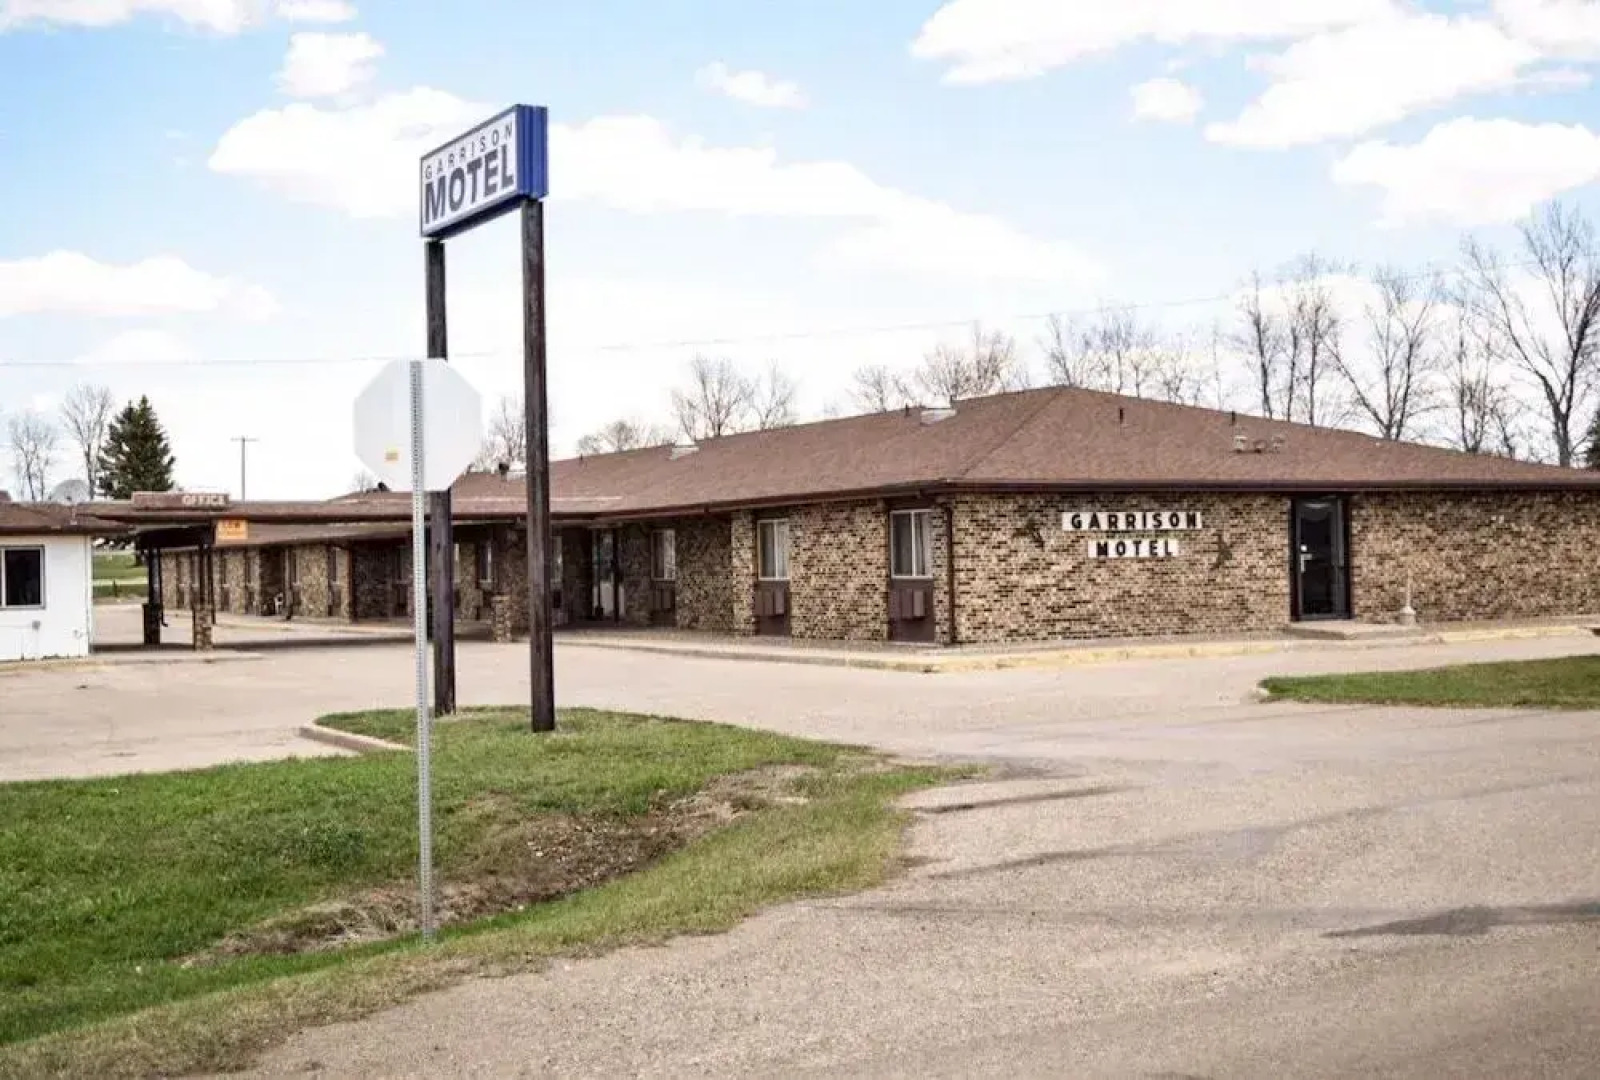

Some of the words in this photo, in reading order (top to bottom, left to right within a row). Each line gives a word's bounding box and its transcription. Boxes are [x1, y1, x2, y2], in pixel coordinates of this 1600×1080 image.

[425, 122, 513, 179] GARRISON
[425, 144, 514, 224] MOTEL
[1071, 512, 1197, 529] GARRISON
[1097, 541, 1173, 556] MOTEL
